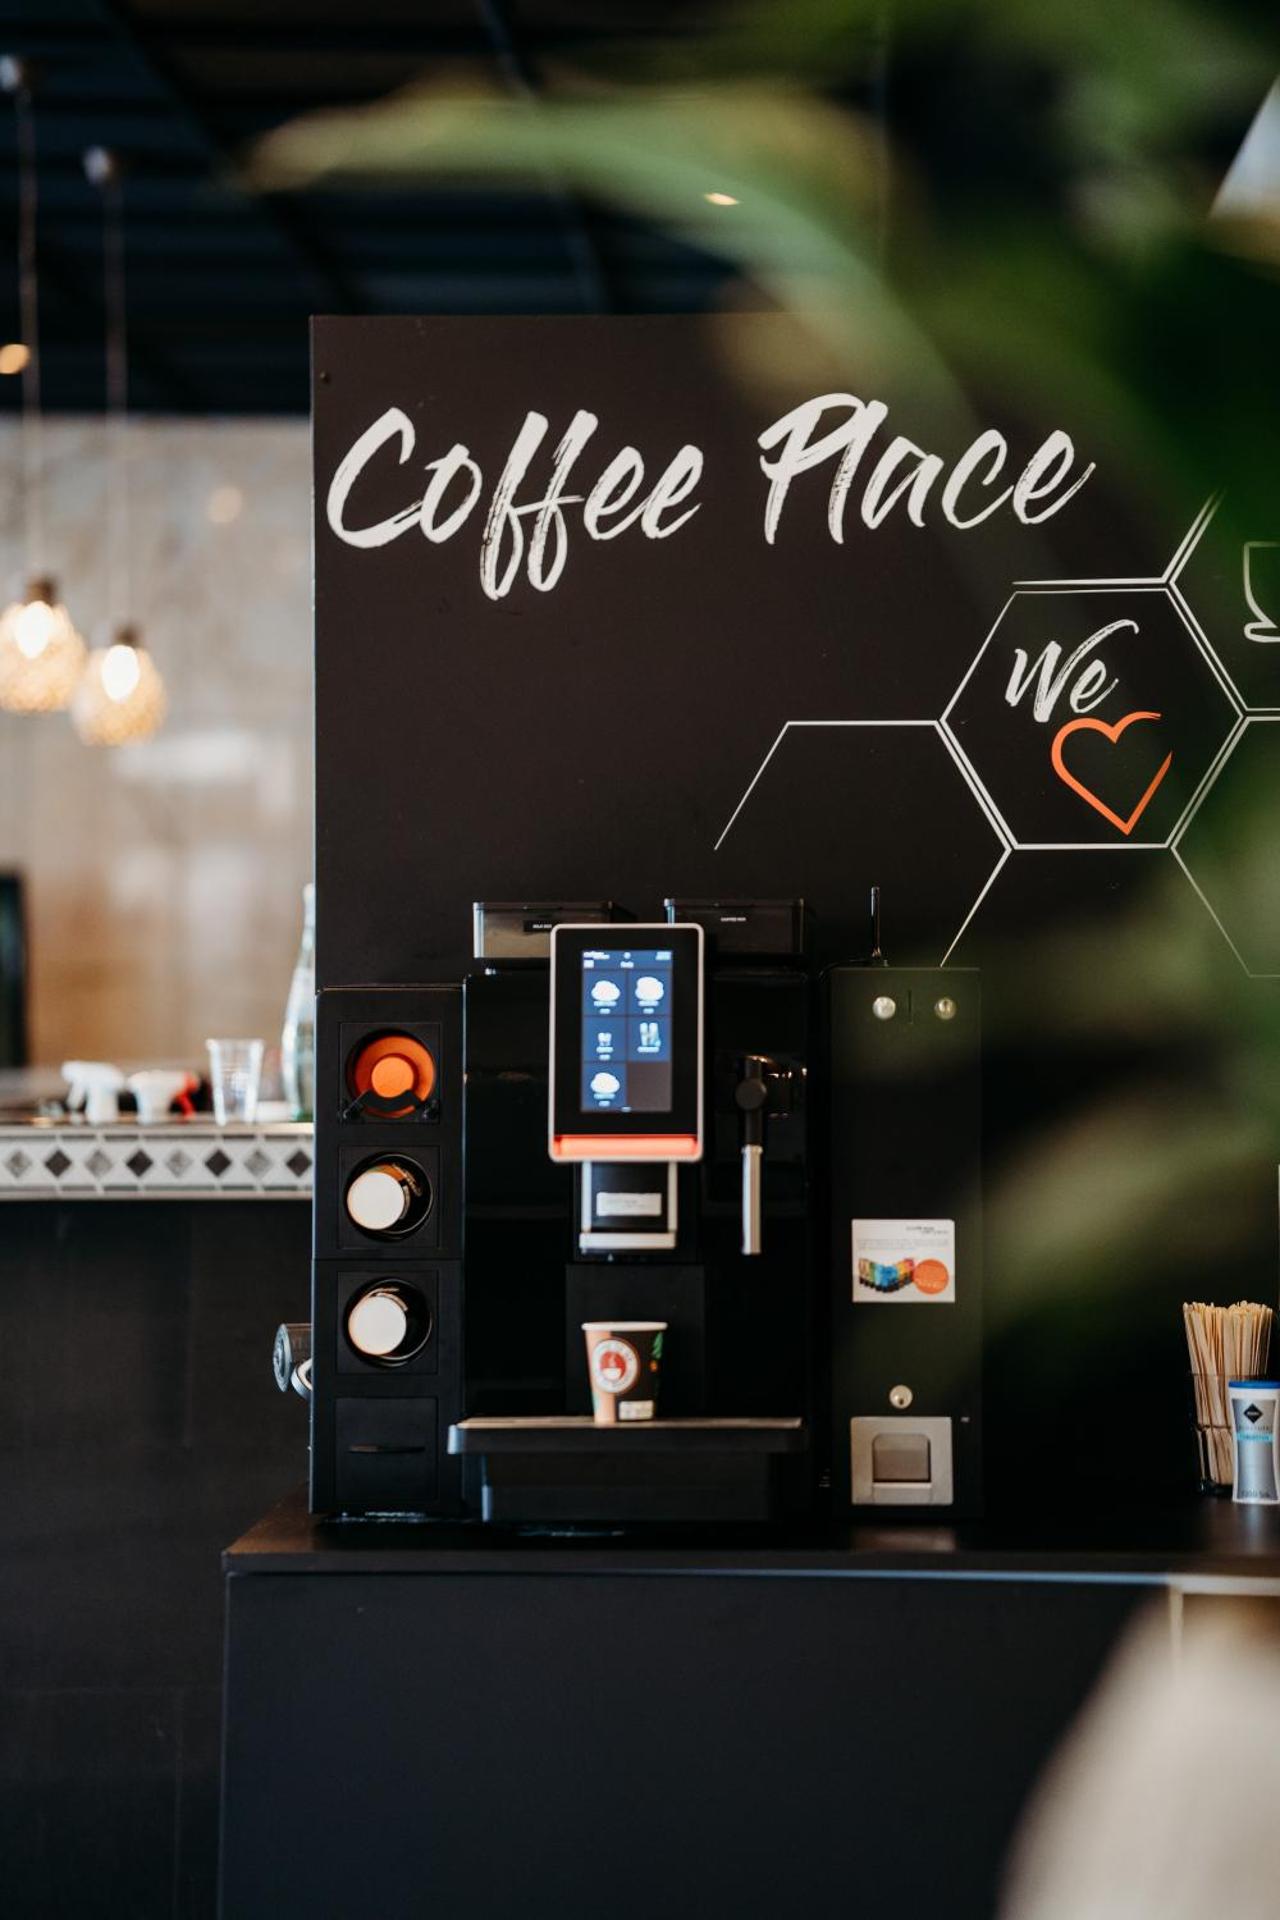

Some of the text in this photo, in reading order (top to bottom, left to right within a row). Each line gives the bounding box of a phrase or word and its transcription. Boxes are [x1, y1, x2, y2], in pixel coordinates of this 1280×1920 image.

[327, 393, 1097, 600] Coffee Place
[1005, 619, 1139, 722] We
